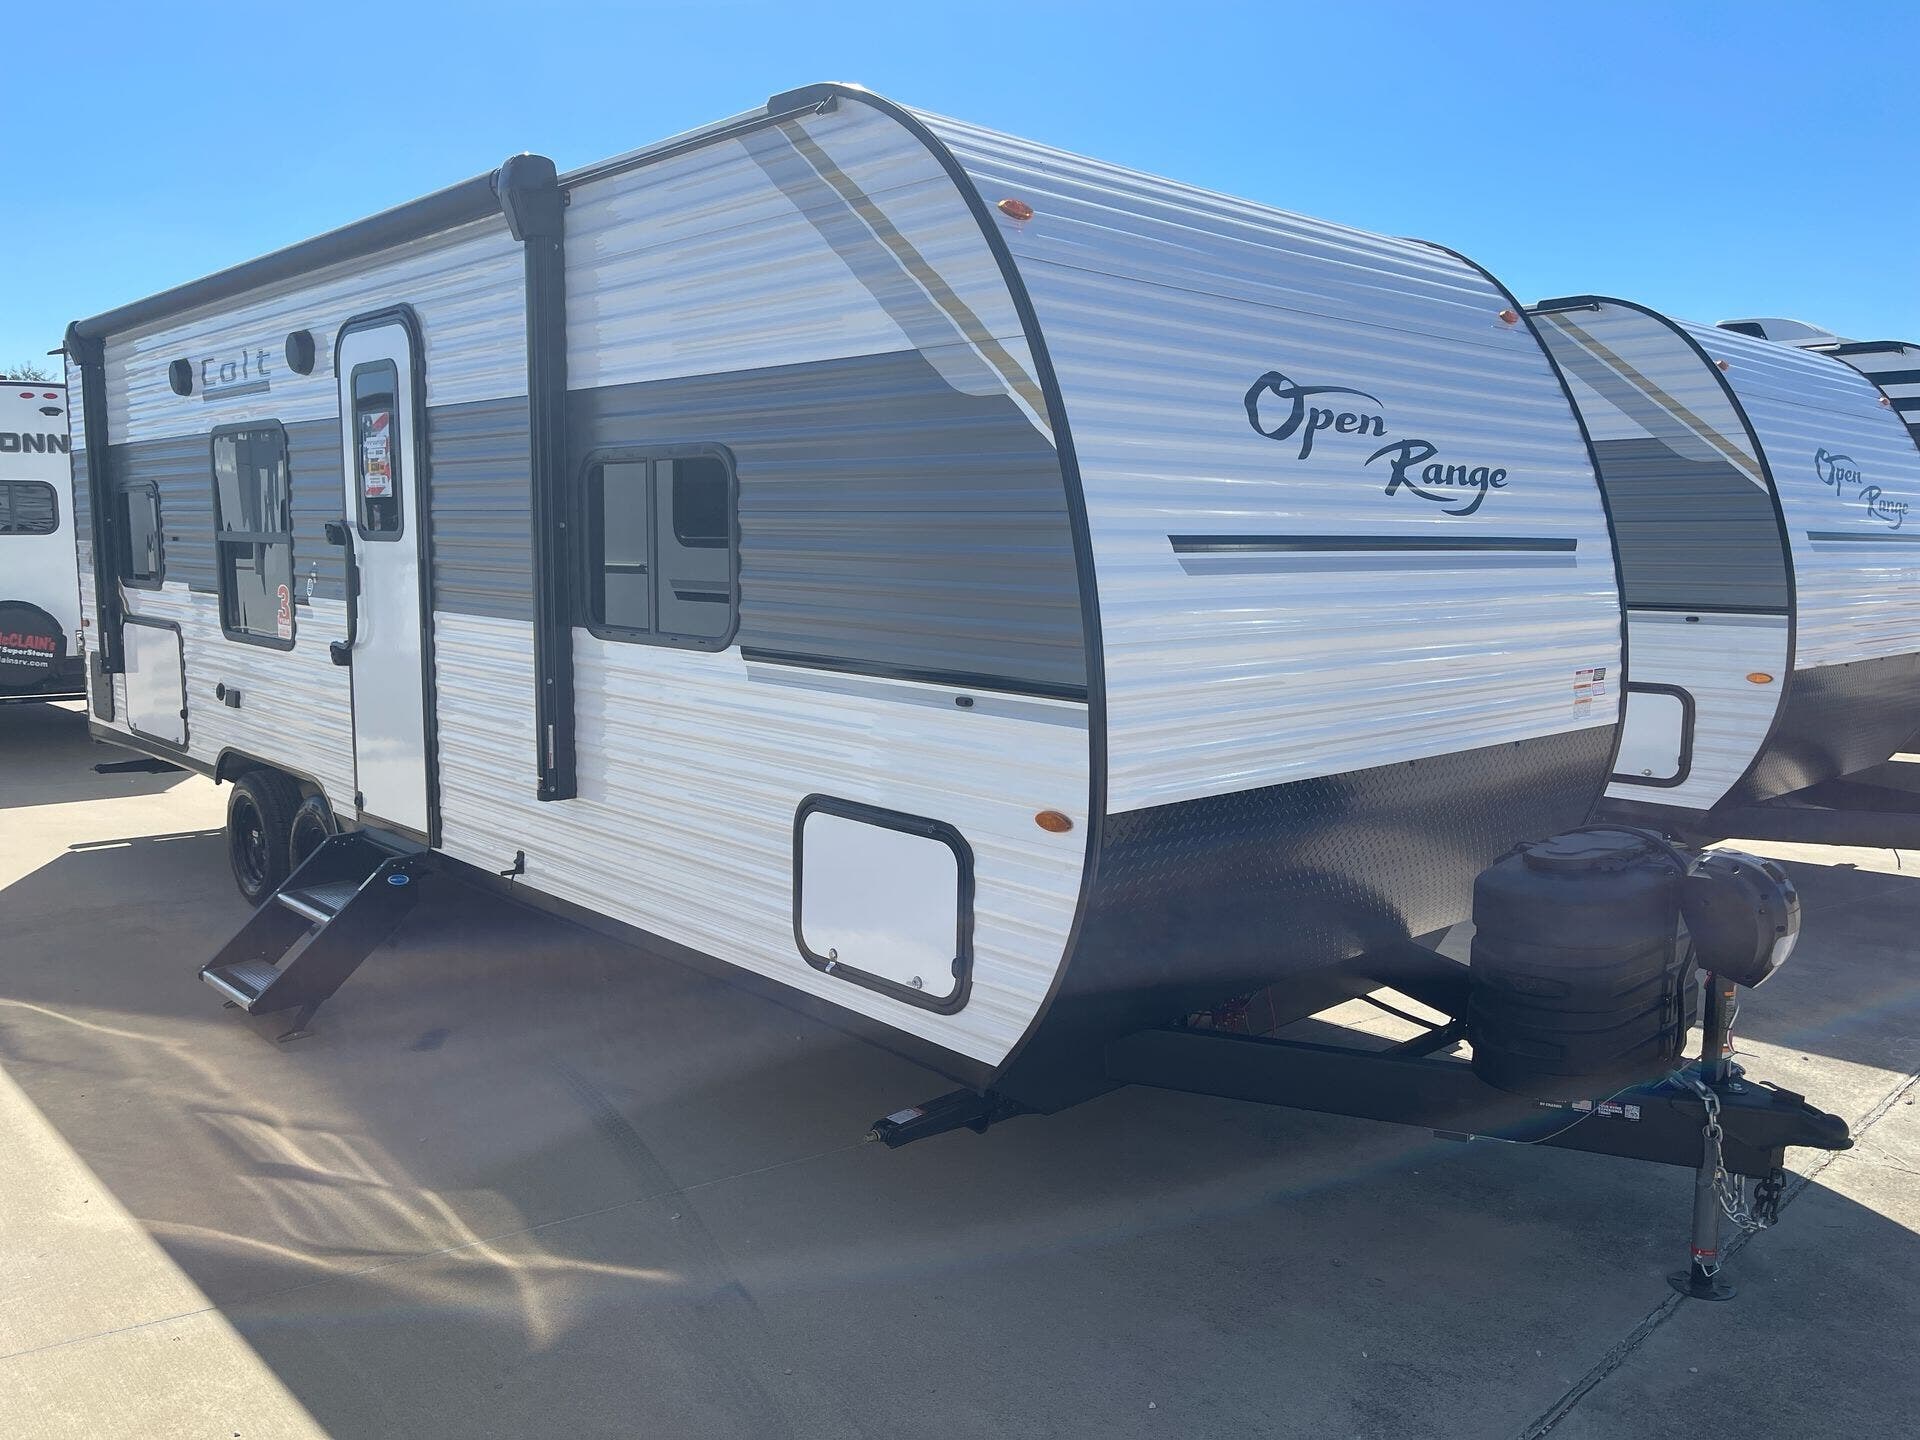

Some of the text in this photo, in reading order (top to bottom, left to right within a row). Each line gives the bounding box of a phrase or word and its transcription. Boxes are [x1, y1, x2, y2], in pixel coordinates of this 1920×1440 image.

[201, 350, 271, 386] Colt
[1244, 370, 1388, 460] Open
[0, 432, 70, 454] ONN
[1364, 439, 1509, 516] Range
[1814, 447, 1862, 496] Open
[1858, 485, 1909, 530] Range
[278, 584, 291, 618] 3
